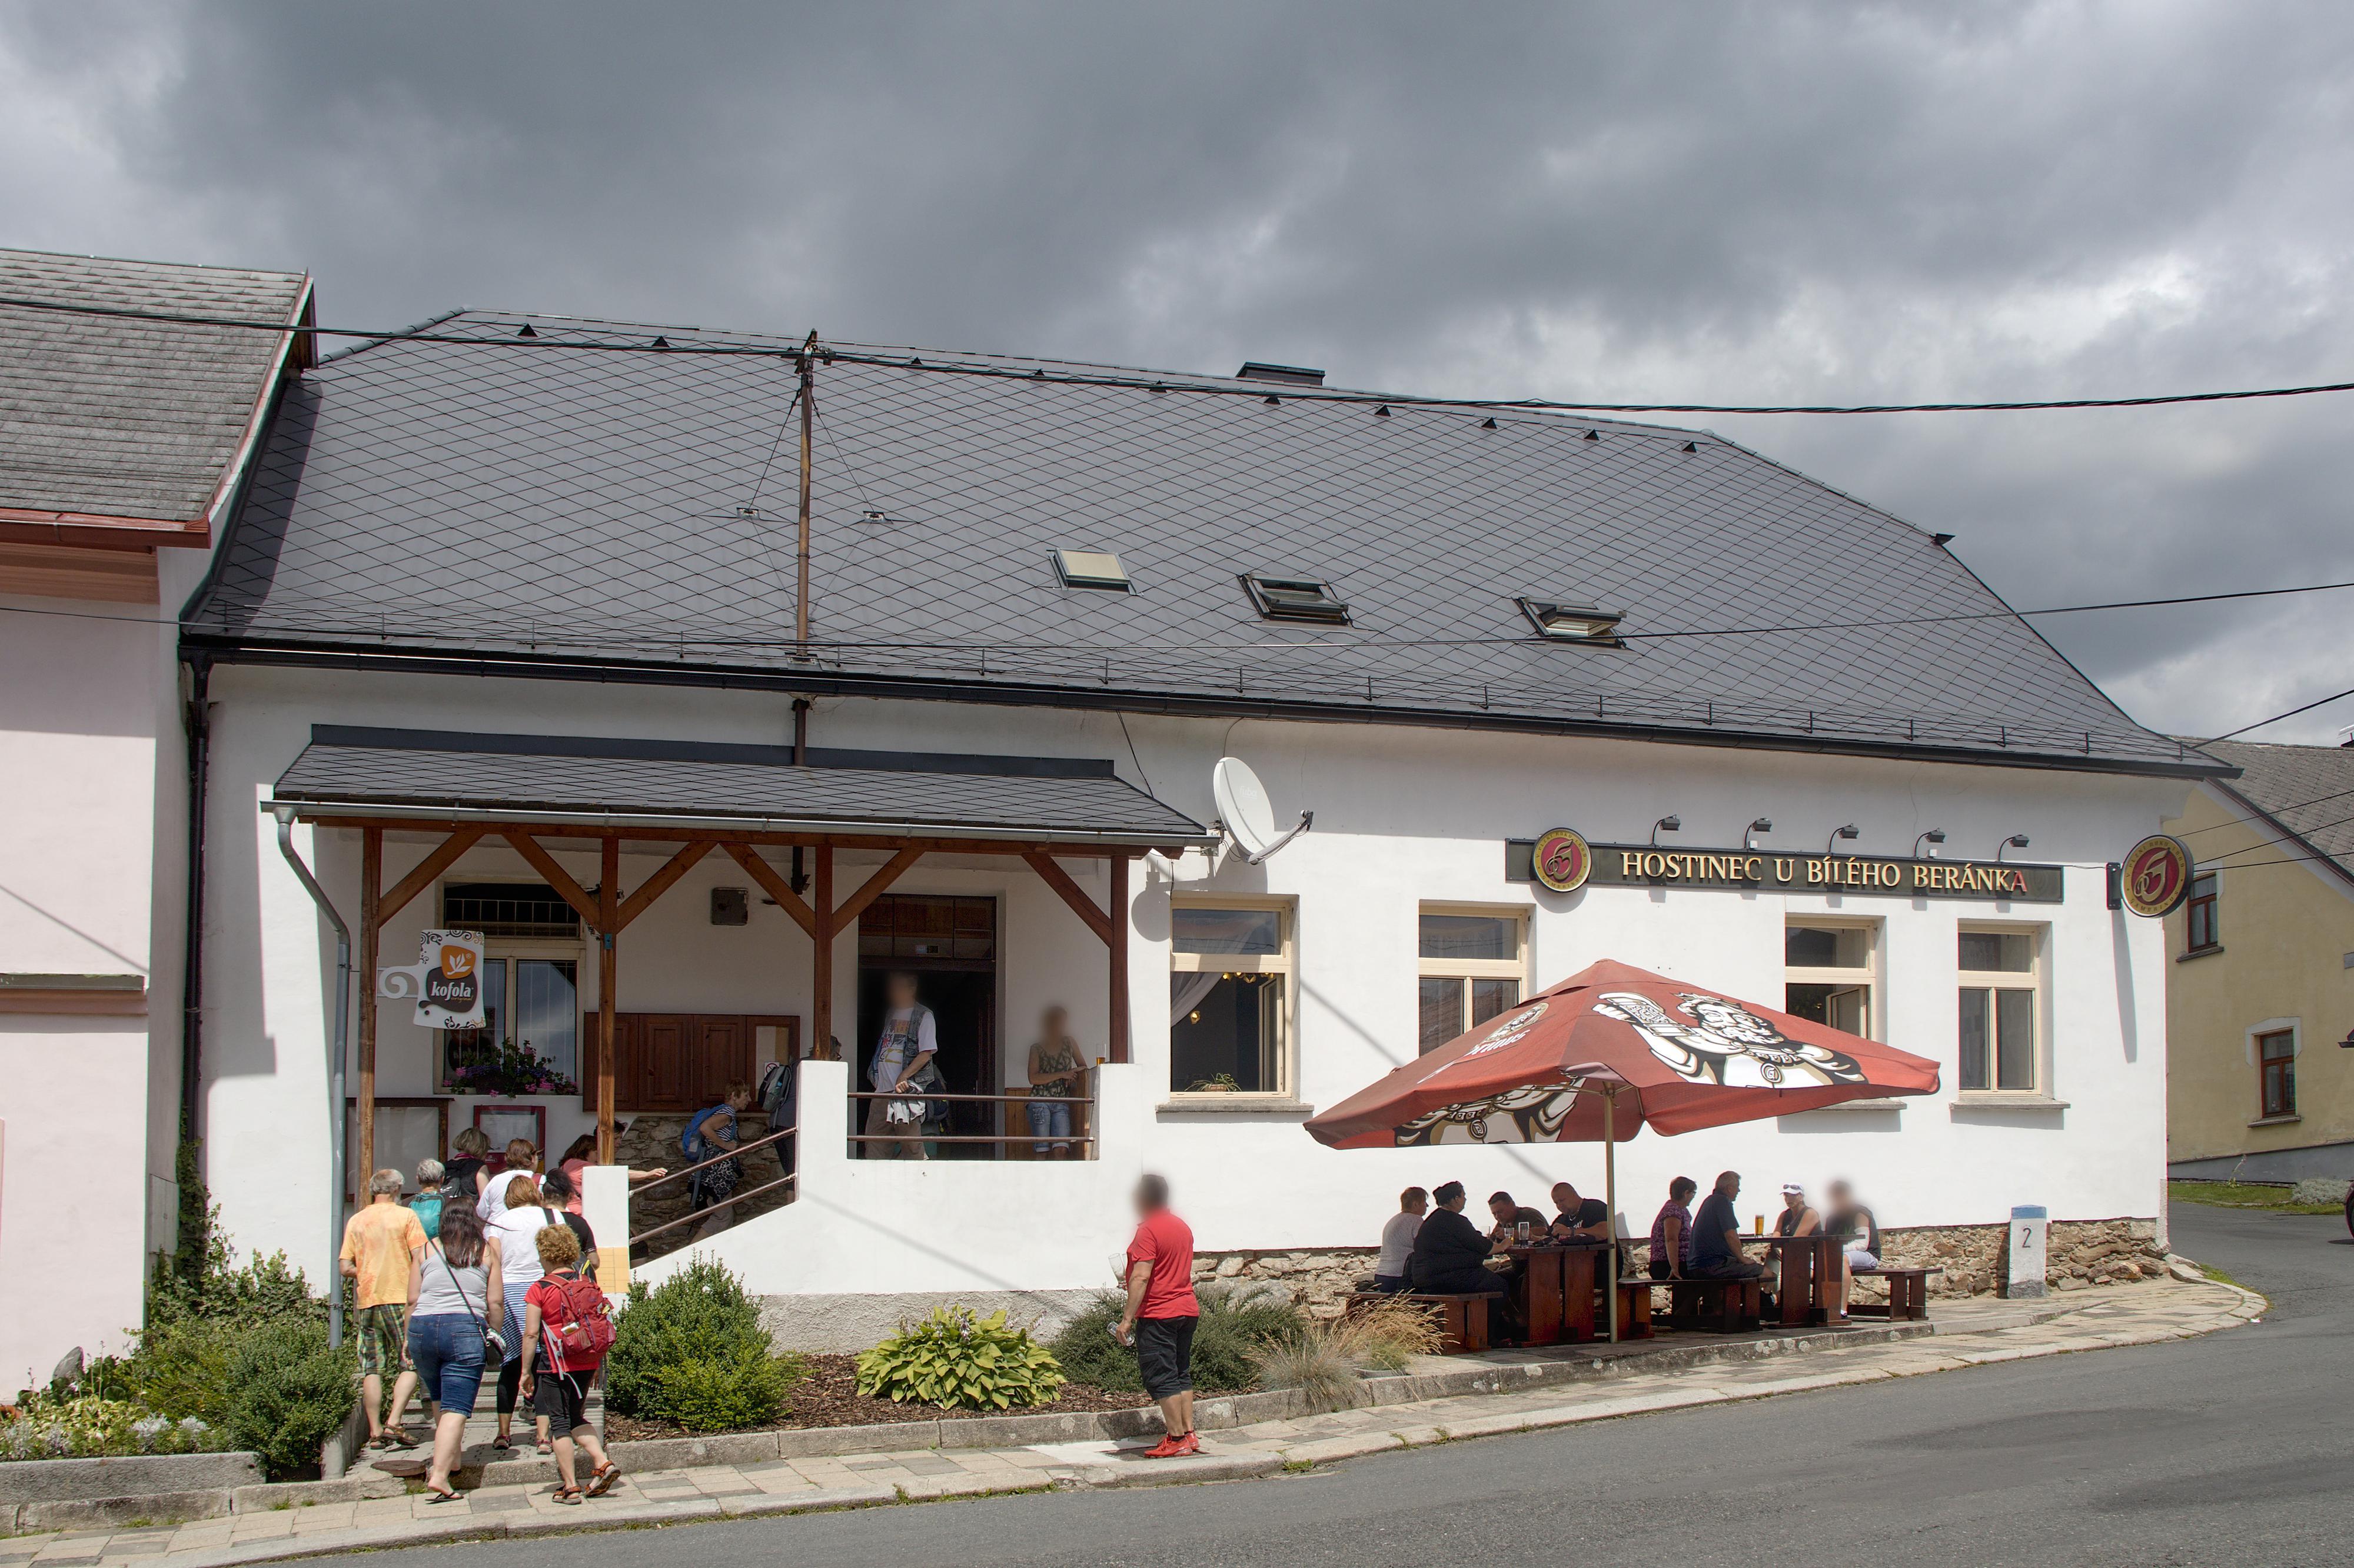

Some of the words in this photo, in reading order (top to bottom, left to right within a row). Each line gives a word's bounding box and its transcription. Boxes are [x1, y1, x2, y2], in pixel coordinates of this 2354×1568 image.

[1621, 853, 1761, 881] HOSTINEC
[1774, 858, 1795, 882] U
[1806, 856, 1900, 887] BÍLÉHO
[1913, 863, 2027, 892] BERÁNKA
[431, 981, 471, 1001] kofola
[2022, 1227, 2032, 1248] 2
